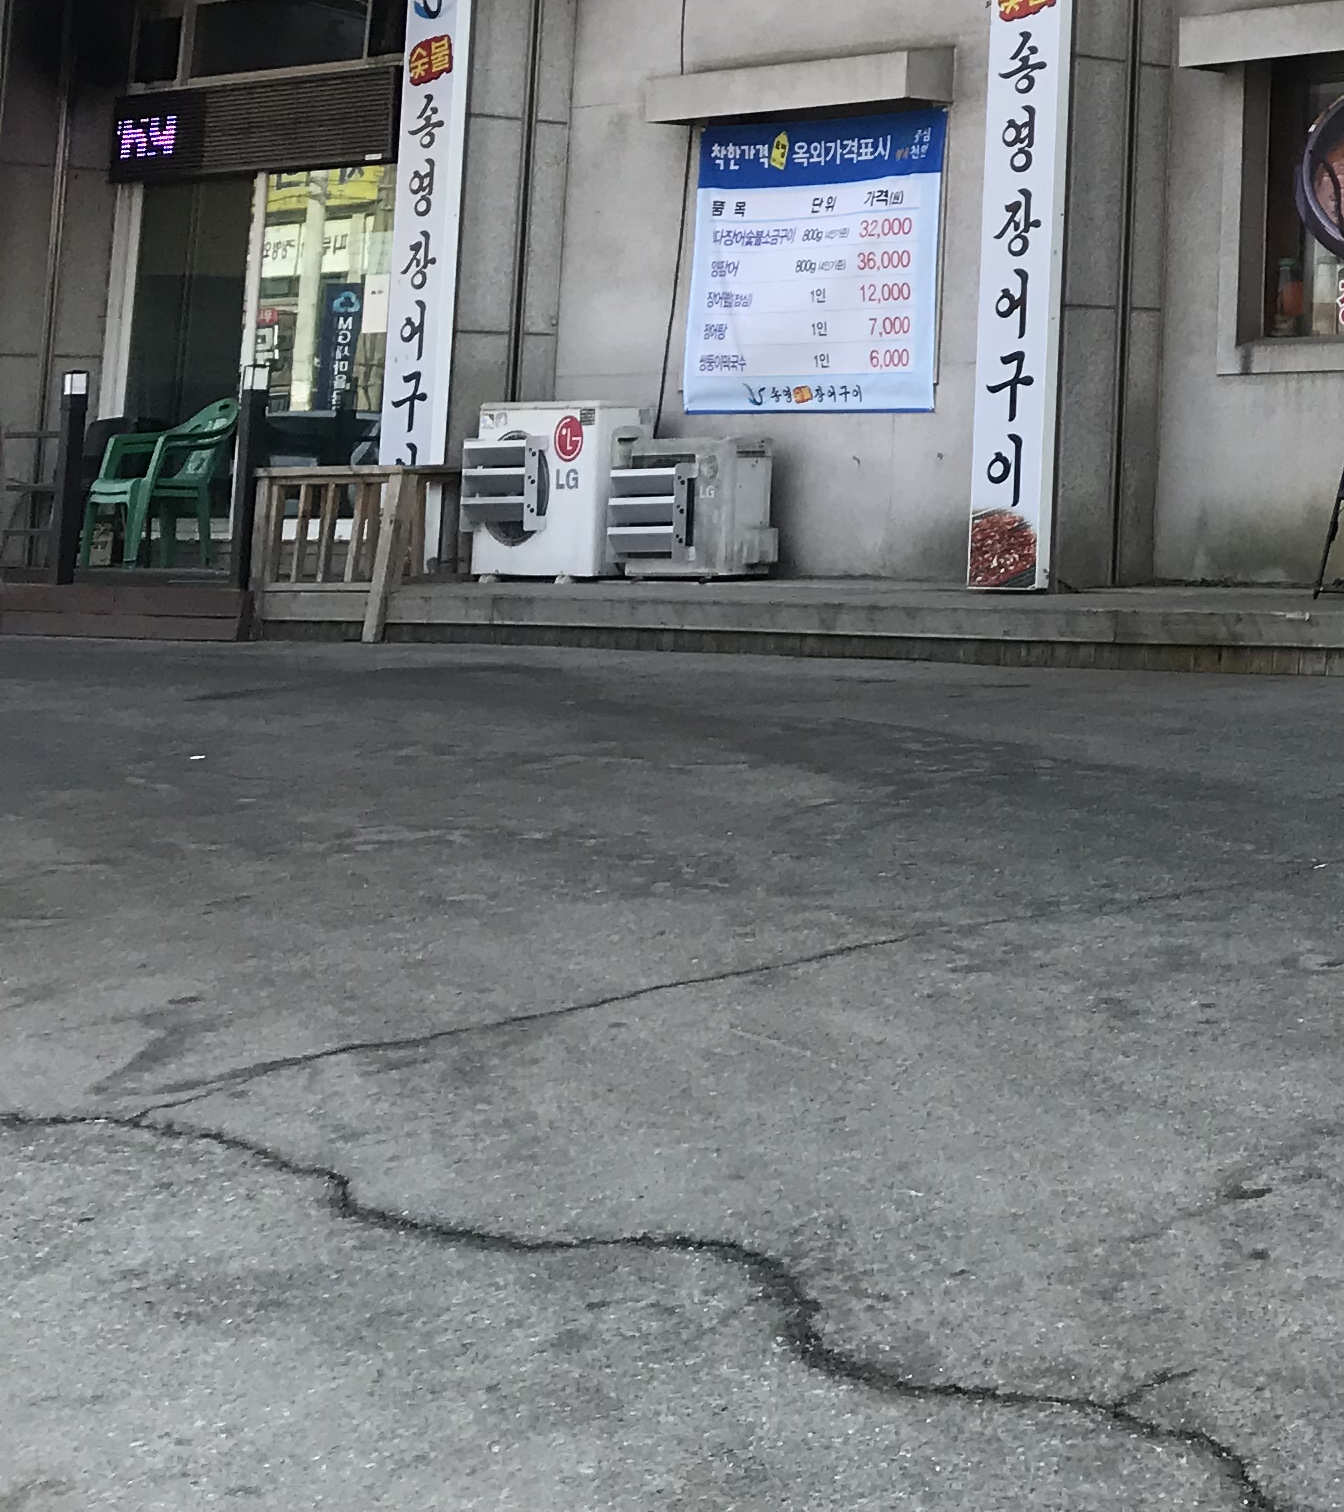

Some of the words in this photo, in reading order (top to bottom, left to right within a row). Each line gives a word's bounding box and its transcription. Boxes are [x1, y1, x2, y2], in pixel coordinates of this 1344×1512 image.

[409, 37, 452, 78] 숯불
[711, 141, 770, 171] 착한가격
[792, 134, 892, 169] 옥외가격표시
[858, 216, 913, 239] 32,000
[856, 248, 911, 271] 36,000
[985, 30, 1049, 510] 송영장어구이
[859, 281, 911, 304] 12,000
[868, 315, 911, 338] 7,000
[869, 348, 910, 370] 6,000
[555, 468, 579, 490] LG
[698, 486, 715, 499] LG
